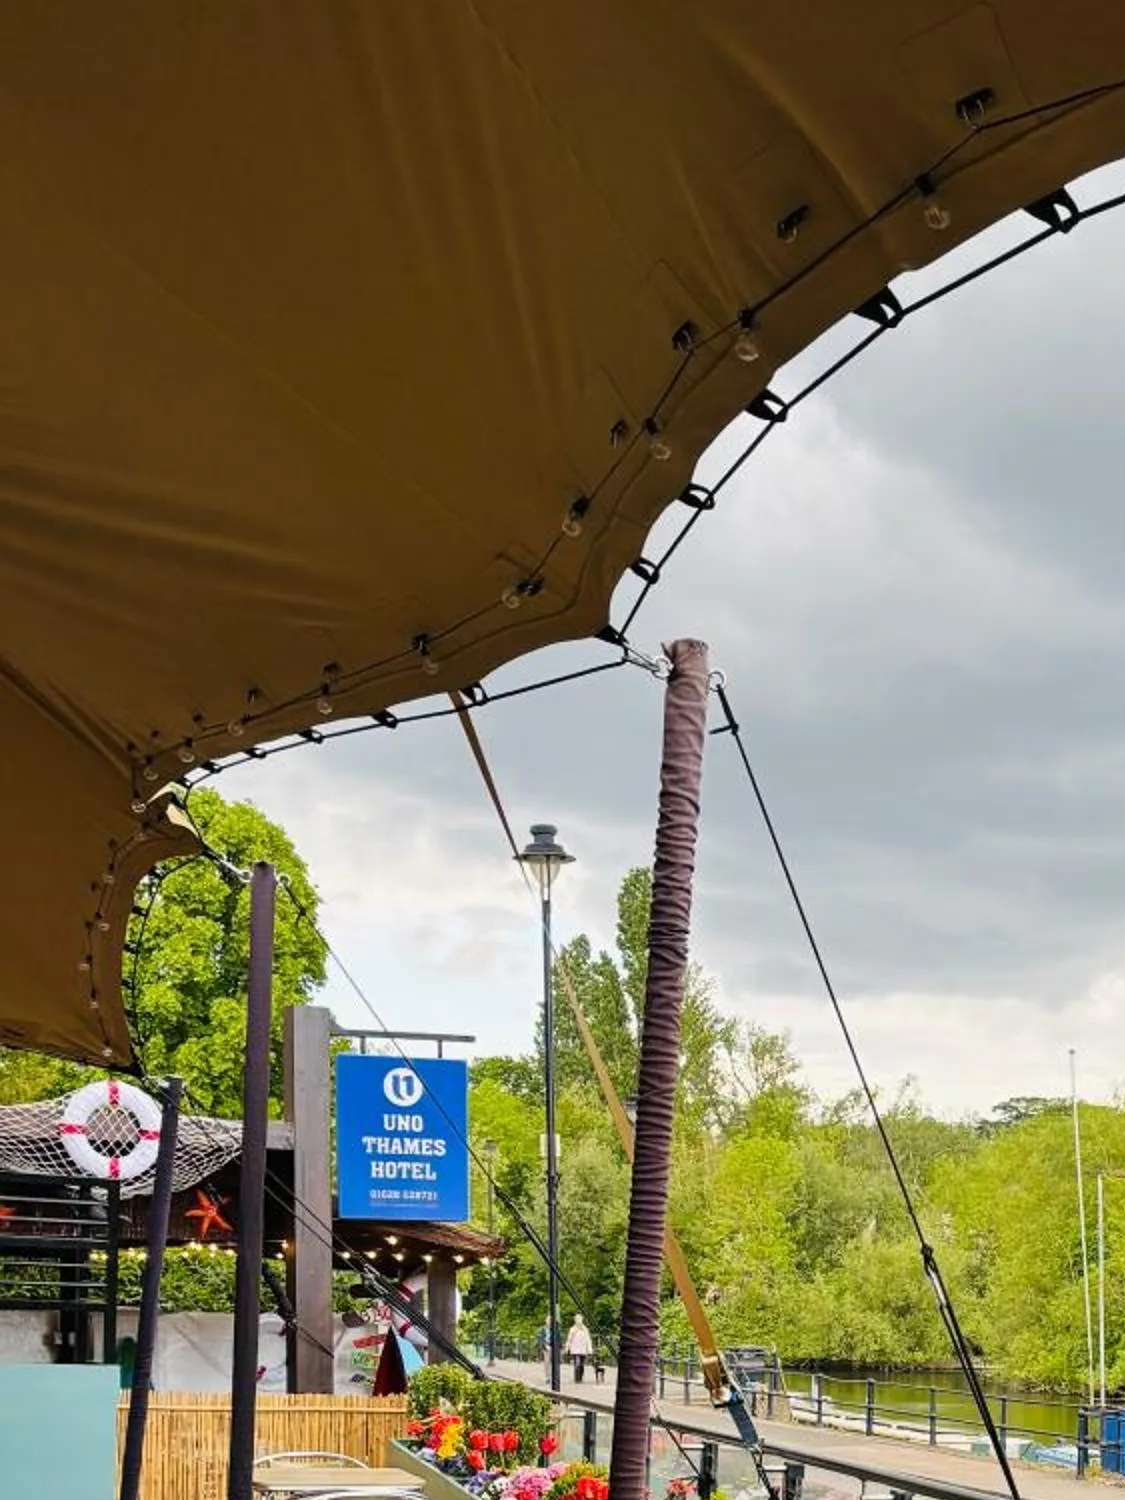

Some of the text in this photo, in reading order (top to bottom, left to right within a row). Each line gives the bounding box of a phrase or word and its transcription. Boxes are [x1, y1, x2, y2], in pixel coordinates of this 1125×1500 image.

[383, 1114, 424, 1132] UNO
[361, 1136, 447, 1157] THAMES
[371, 1161, 437, 1181] HOTEL
